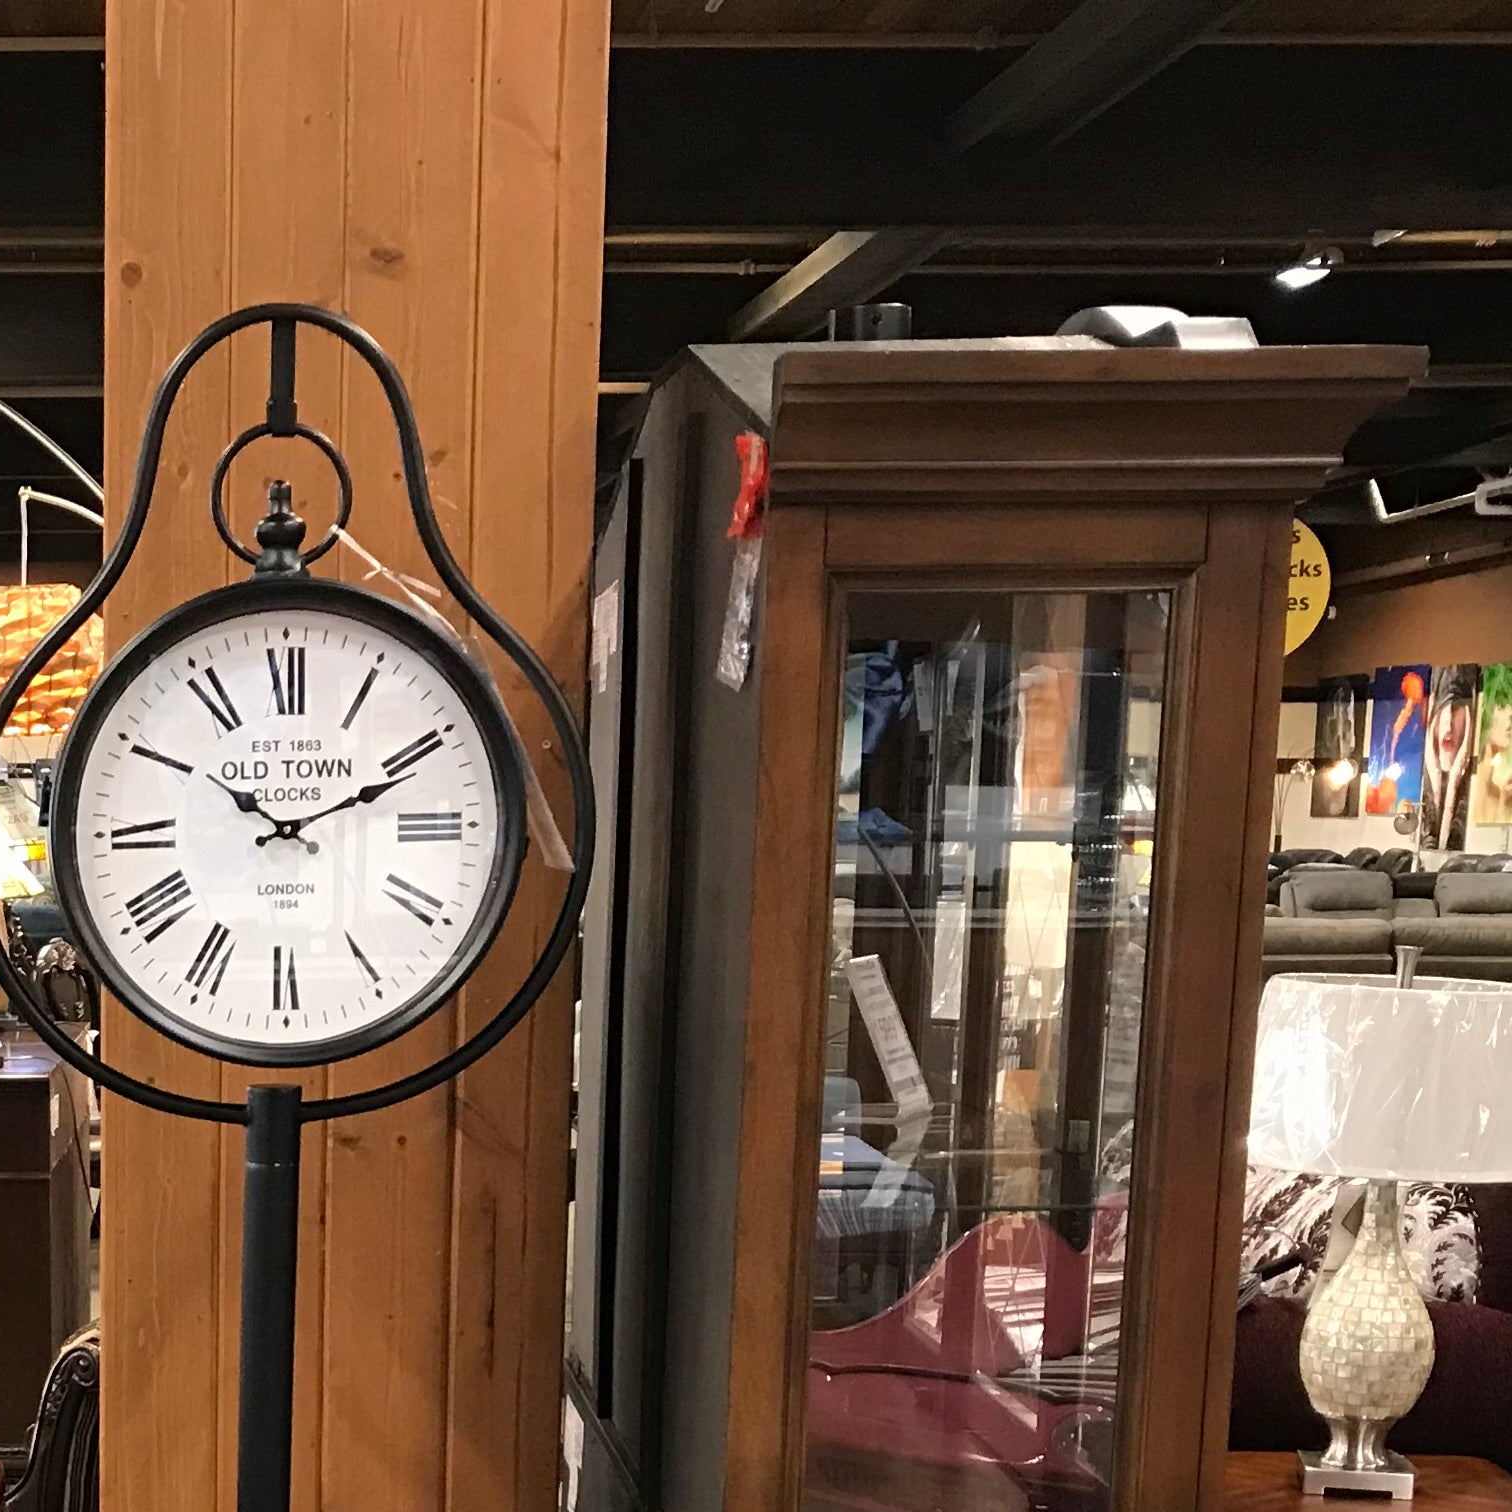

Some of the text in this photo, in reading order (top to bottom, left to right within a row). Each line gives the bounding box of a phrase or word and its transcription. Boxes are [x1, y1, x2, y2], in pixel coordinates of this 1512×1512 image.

[251, 740, 322, 753] EST 1863
[221, 759, 352, 781] OLD TOWN
[253, 787, 322, 802] CLOCKS
[257, 883, 315, 896] LONDON
[273, 899, 299, 909] 1894
